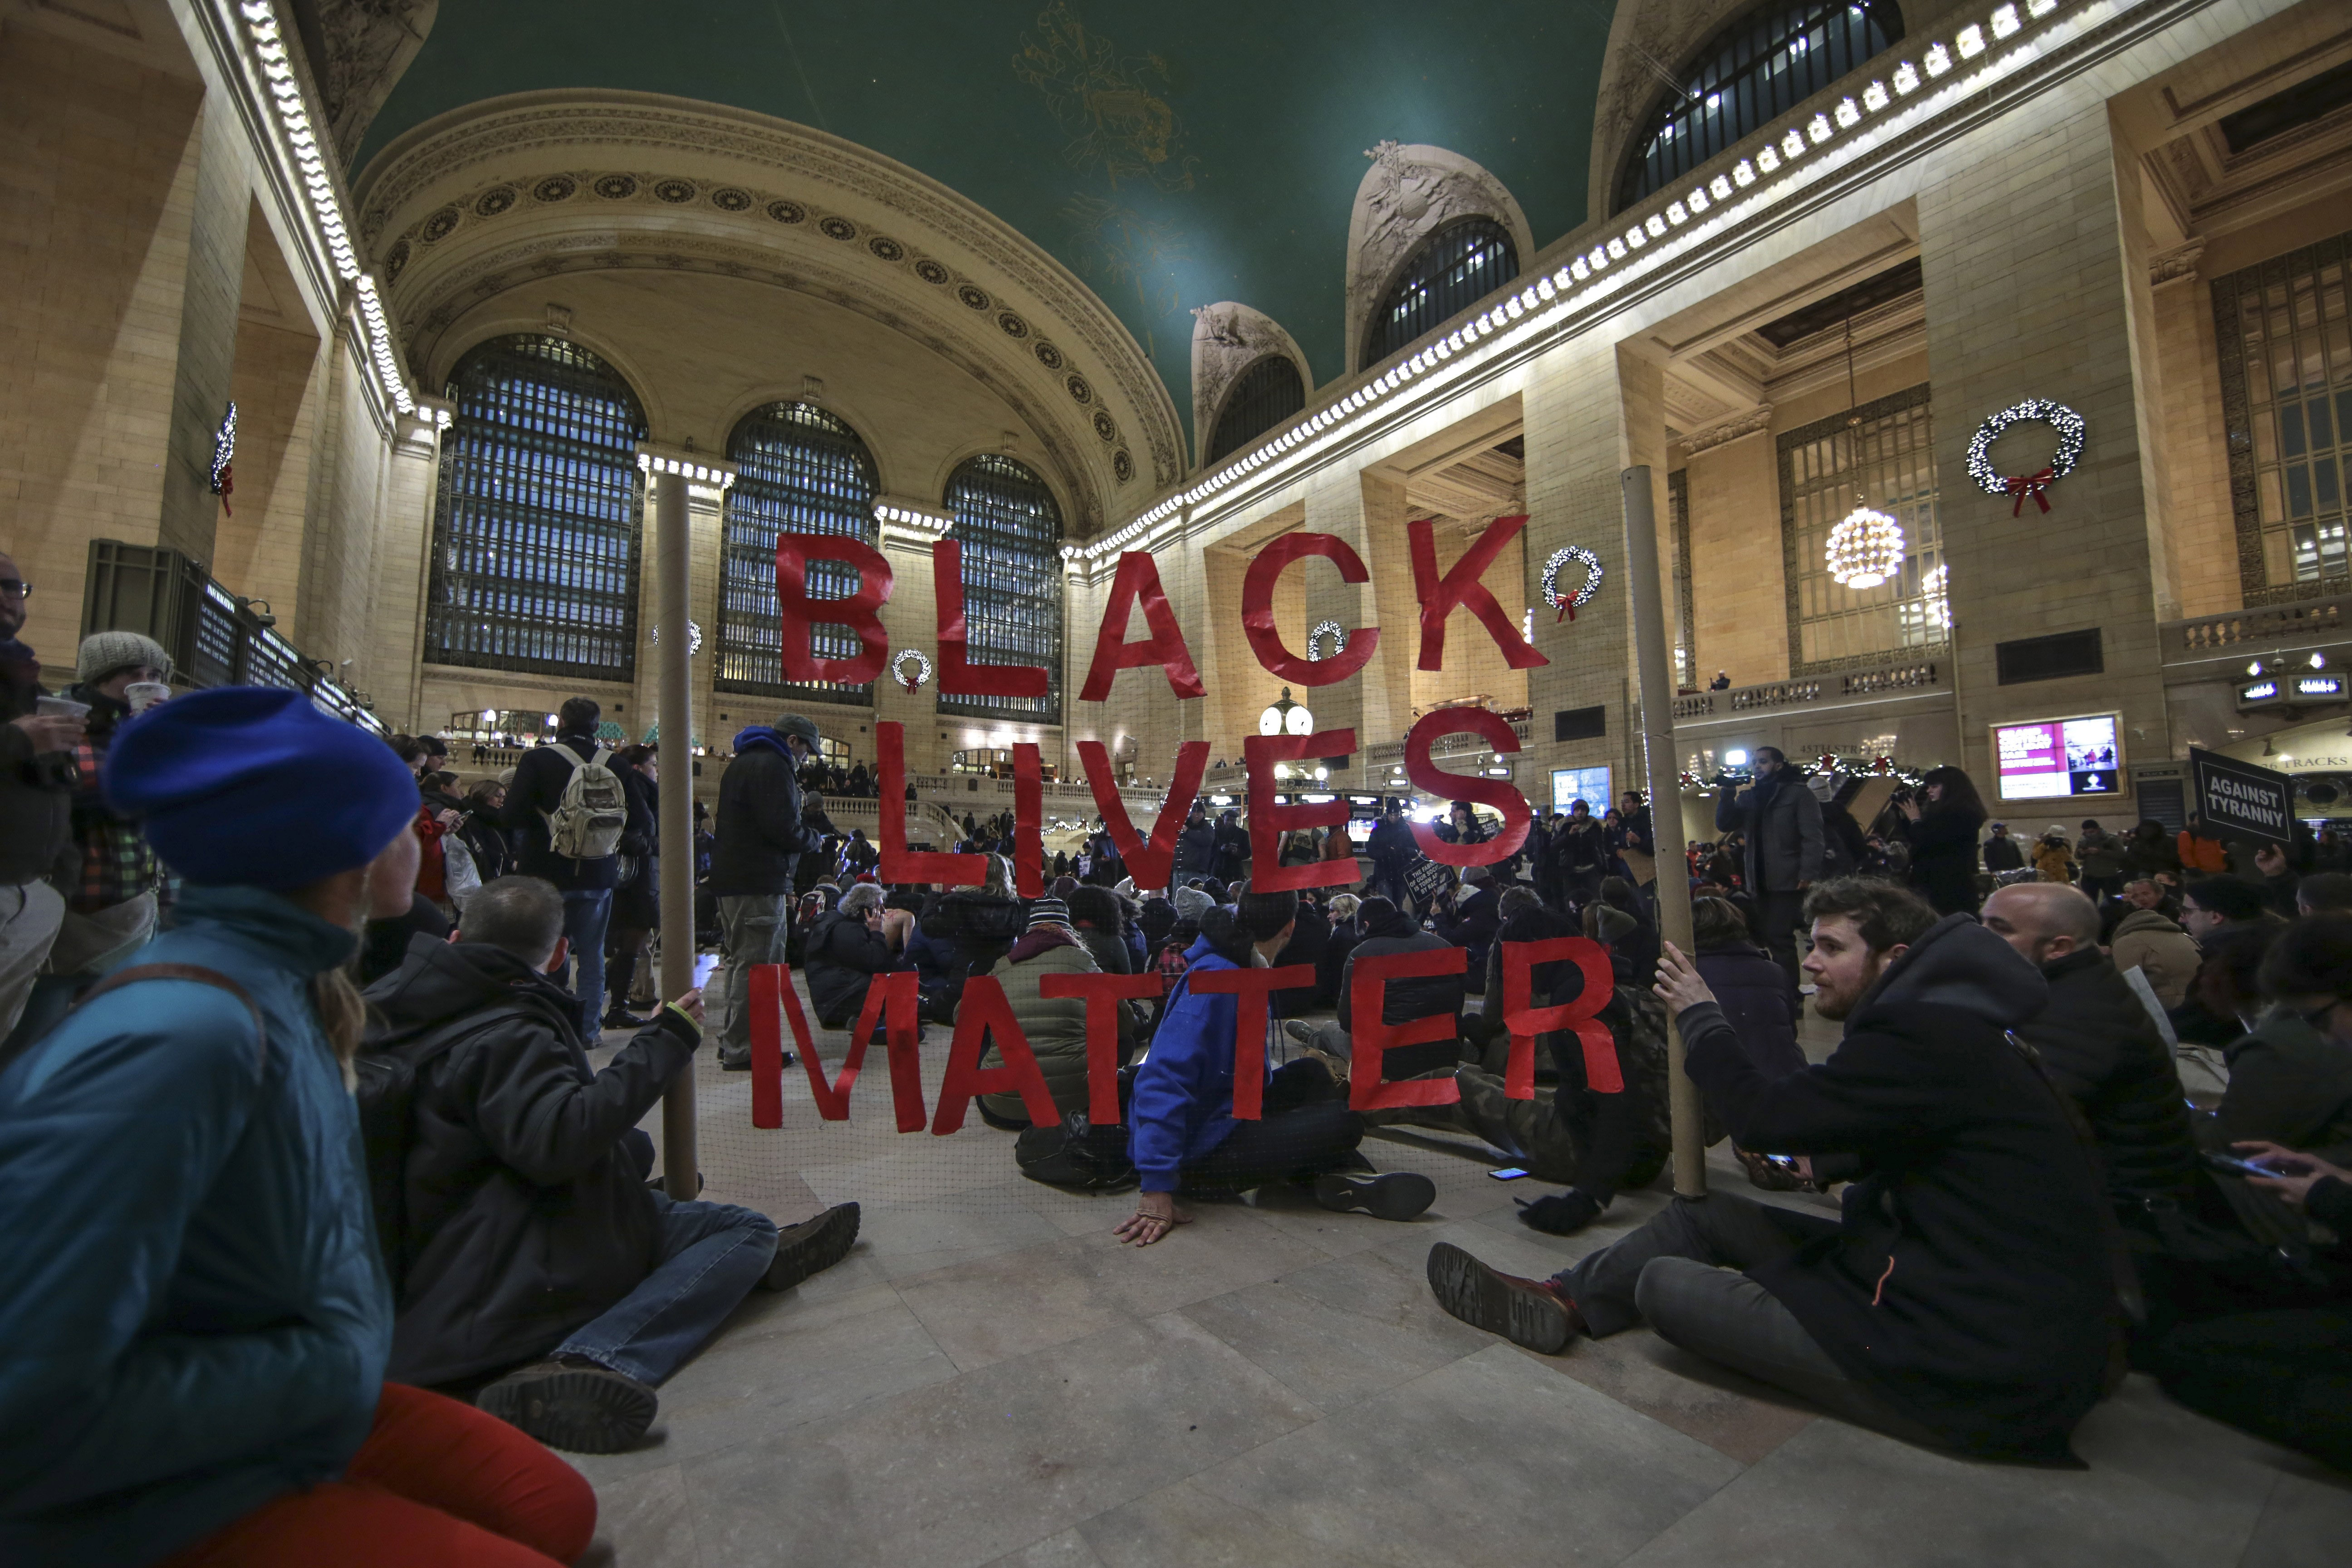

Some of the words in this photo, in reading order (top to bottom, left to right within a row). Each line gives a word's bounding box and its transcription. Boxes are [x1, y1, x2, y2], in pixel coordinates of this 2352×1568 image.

[776, 515, 1548, 701] BLACK
[2283, 757, 2347, 769] TRACKS
[876, 707, 1530, 899] LIVES
[2210, 776, 2278, 808] AGAINST
[2208, 794, 2283, 828] TYRANNY
[1417, 873, 1427, 883] OUR
[1419, 876, 1432, 889] TORN
[1428, 881, 1437, 891] RAC
[749, 936, 1625, 1135] MATTER
